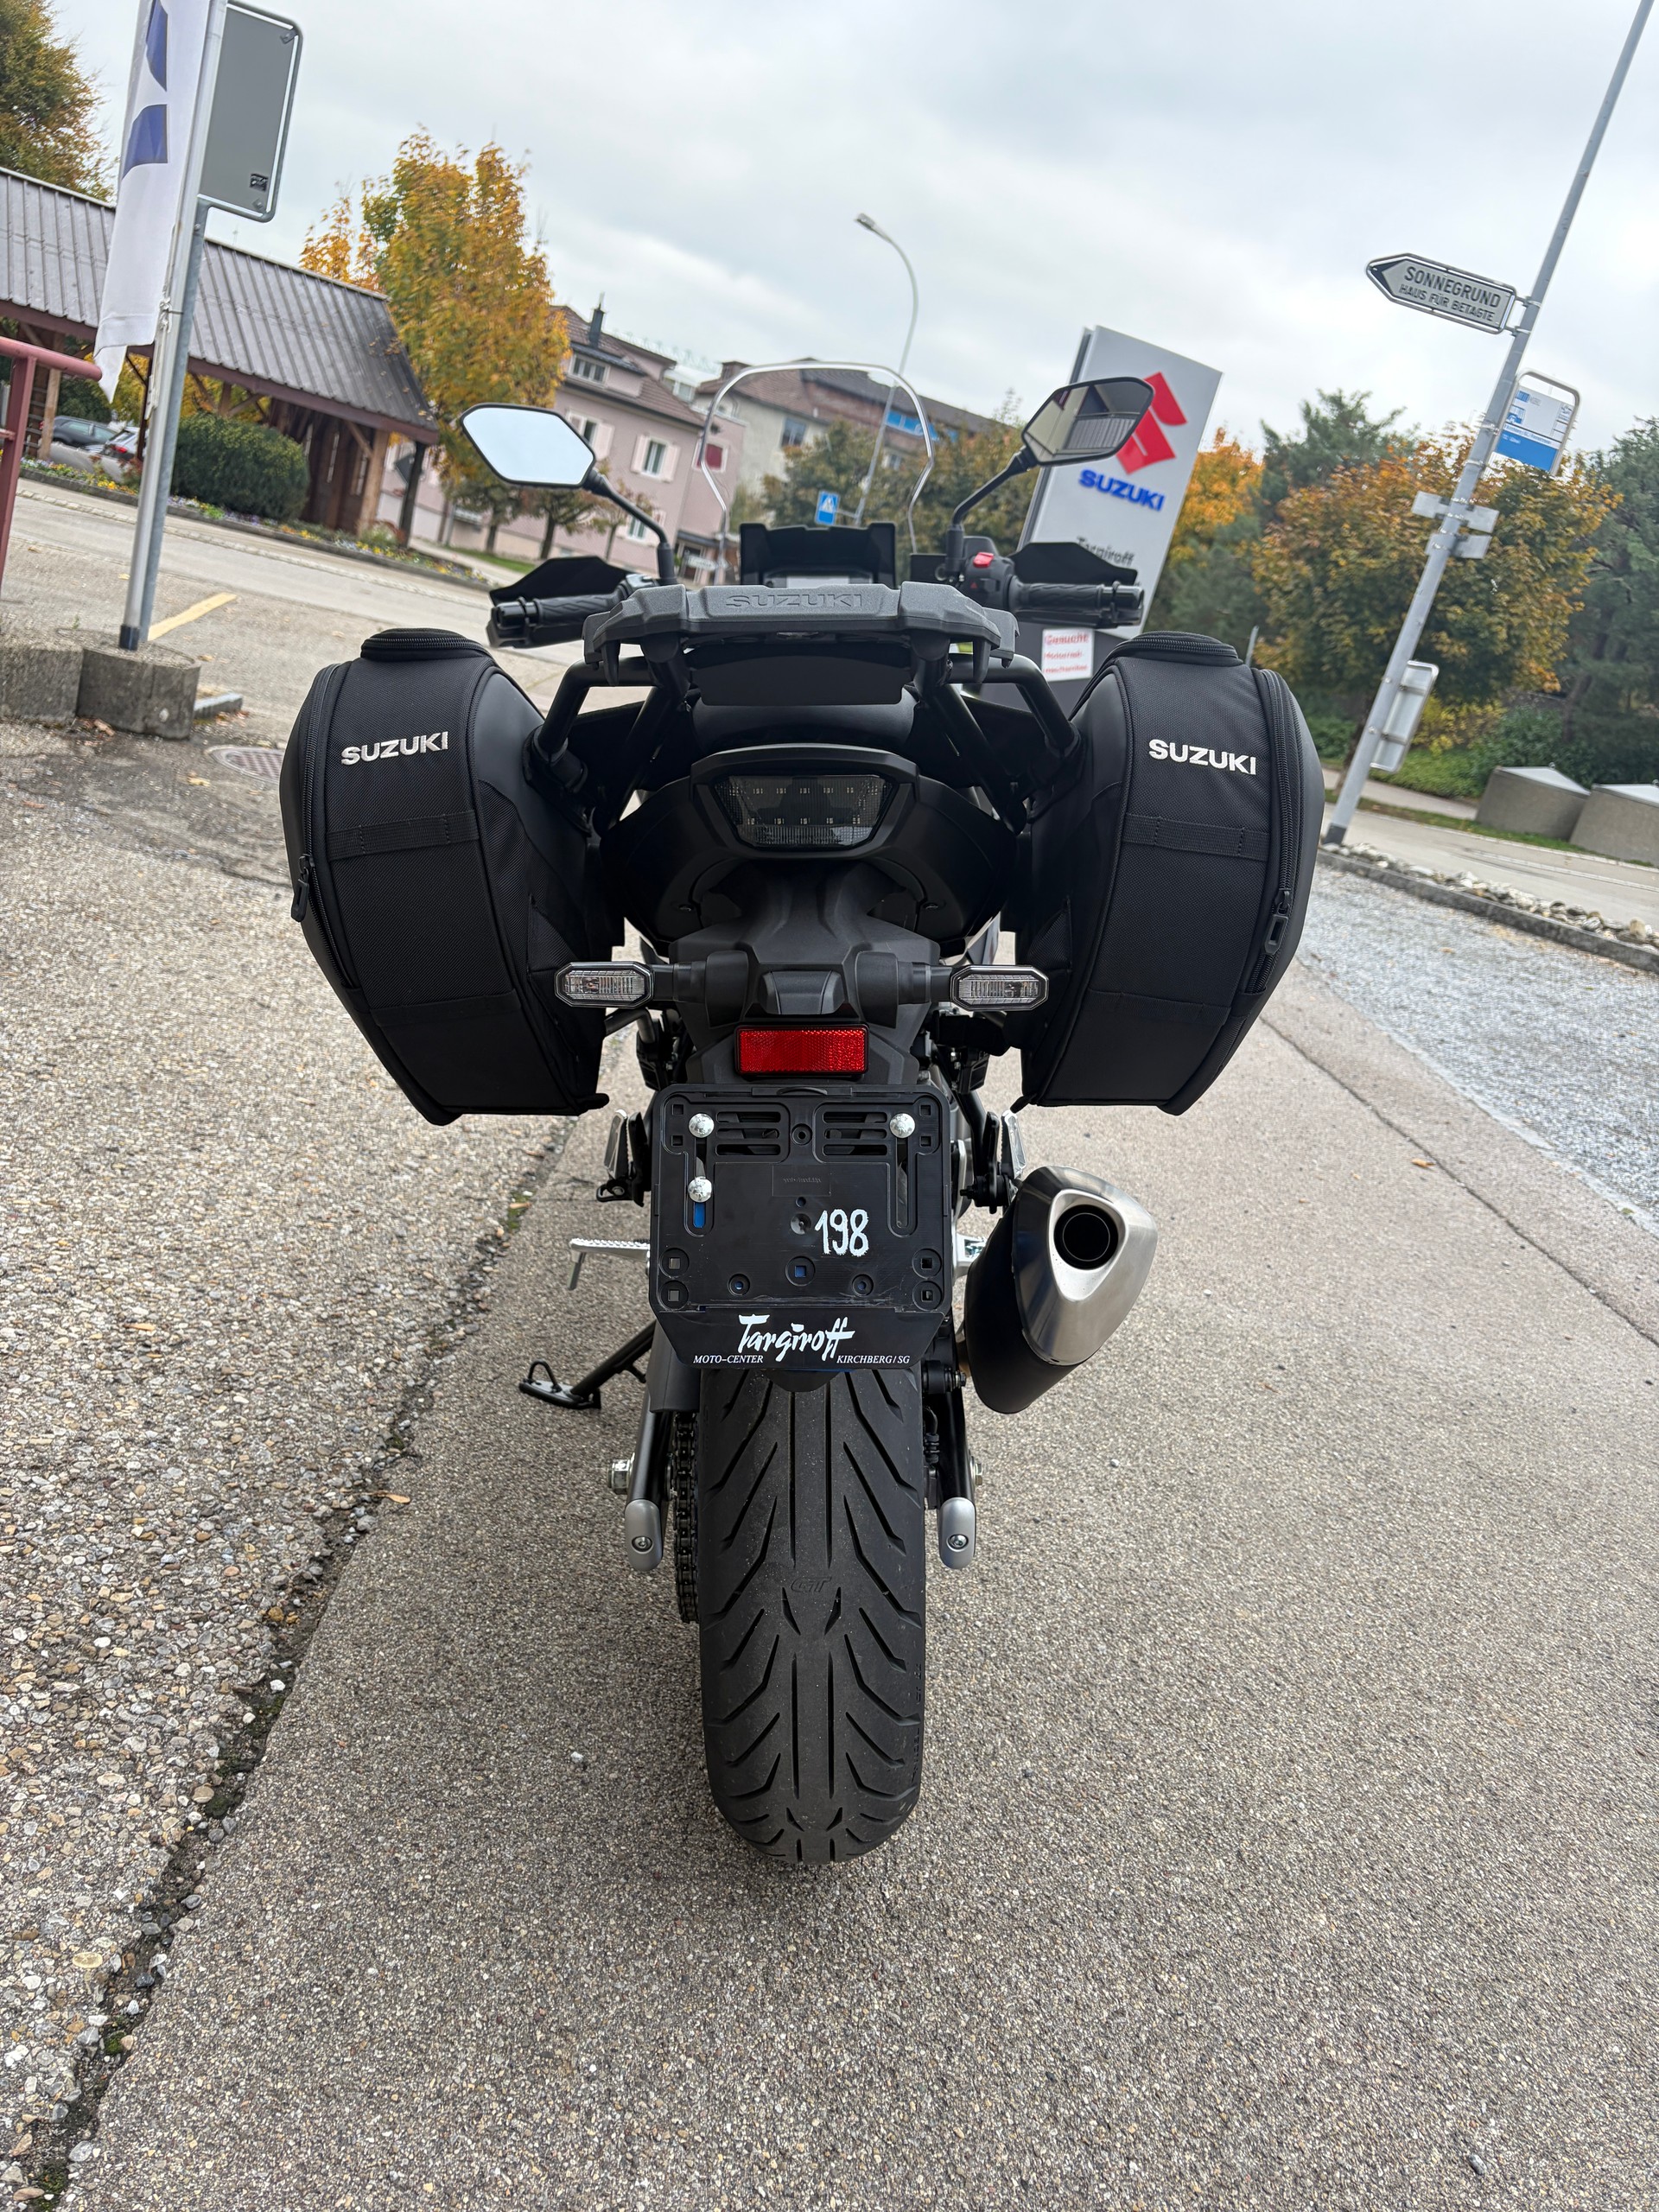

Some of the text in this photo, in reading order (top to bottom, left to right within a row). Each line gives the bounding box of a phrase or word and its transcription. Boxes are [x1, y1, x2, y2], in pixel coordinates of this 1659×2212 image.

[1399, 283, 1496, 322] HAUS FÜR BETAGTE
[1404, 266, 1501, 308] SONNEGRUND
[1078, 469, 1165, 512] SUZUKI
[725, 593, 862, 607] SUZUKI
[341, 731, 448, 765] SUZUKI
[1148, 739, 1256, 775] SUZUKI
[815, 1209, 869, 1257] 198
[738, 1313, 855, 1362] Targiroff
[693, 1355, 764, 1363] MOTO-CENTER
